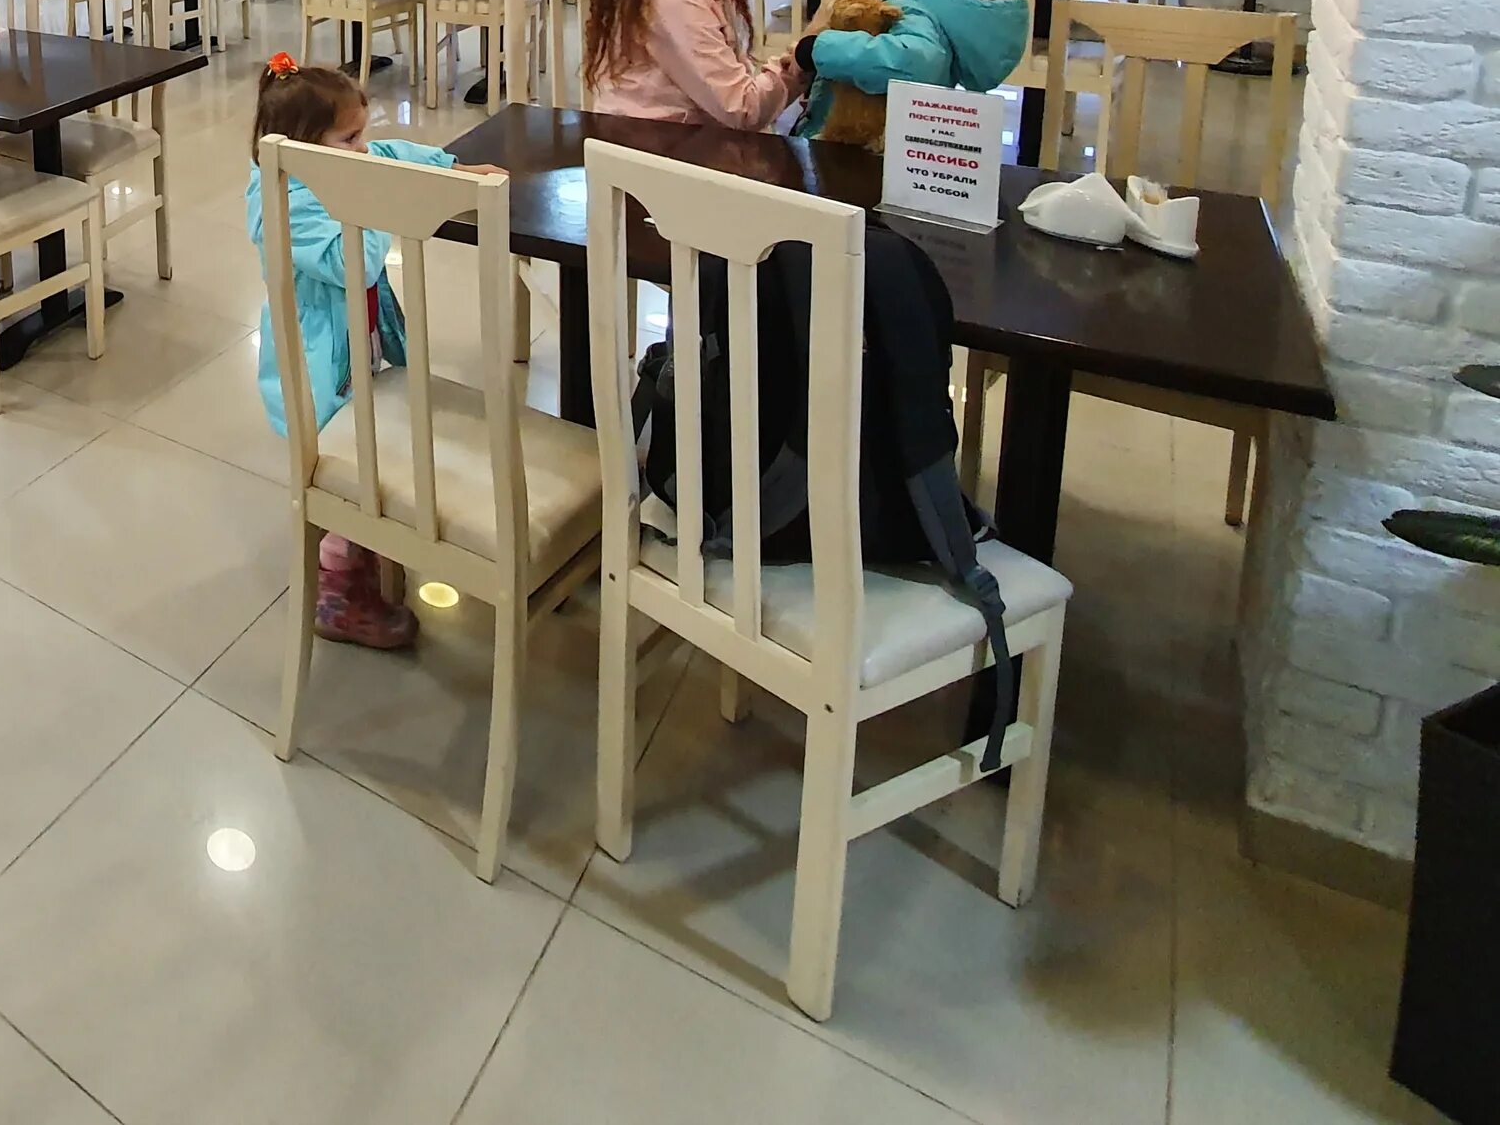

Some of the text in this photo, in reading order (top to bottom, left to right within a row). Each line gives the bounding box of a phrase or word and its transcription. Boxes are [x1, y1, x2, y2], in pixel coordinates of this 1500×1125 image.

[912, 99, 978, 115] УВАЖАЕМЫЕ
[909, 112, 980, 128] ПОСЕТИТЕЛИ!
[906, 149, 979, 170] СПАСИБО
[906, 166, 977, 186] ЧТО УБРАЛИ
[912, 182, 970, 199] ЗА СОБОЙ
